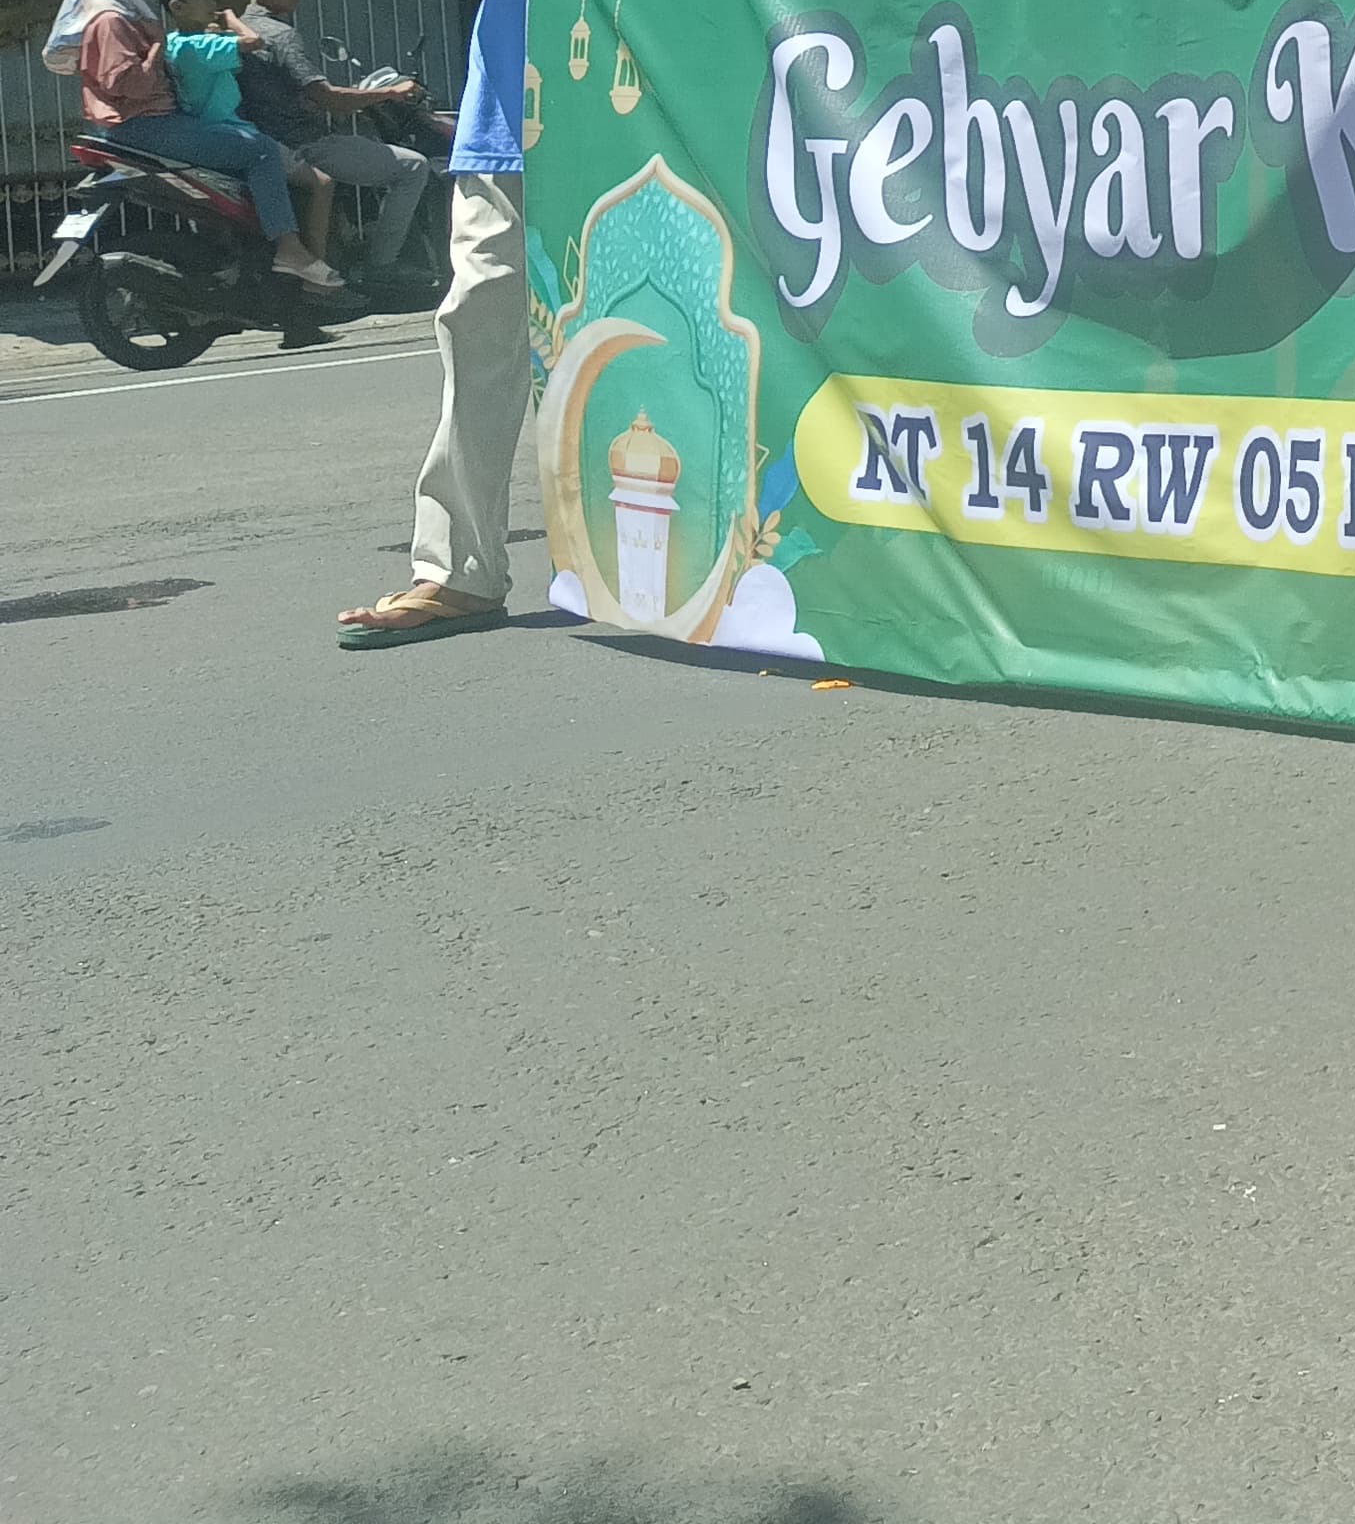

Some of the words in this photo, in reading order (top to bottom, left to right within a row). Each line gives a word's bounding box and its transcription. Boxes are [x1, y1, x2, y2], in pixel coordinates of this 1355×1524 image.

[766, 23, 1233, 317] Gebyar
[855, 409, 938, 501] RT
[966, 422, 1048, 513] 14
[1074, 431, 1215, 525] RW
[1239, 436, 1321, 534] 05
